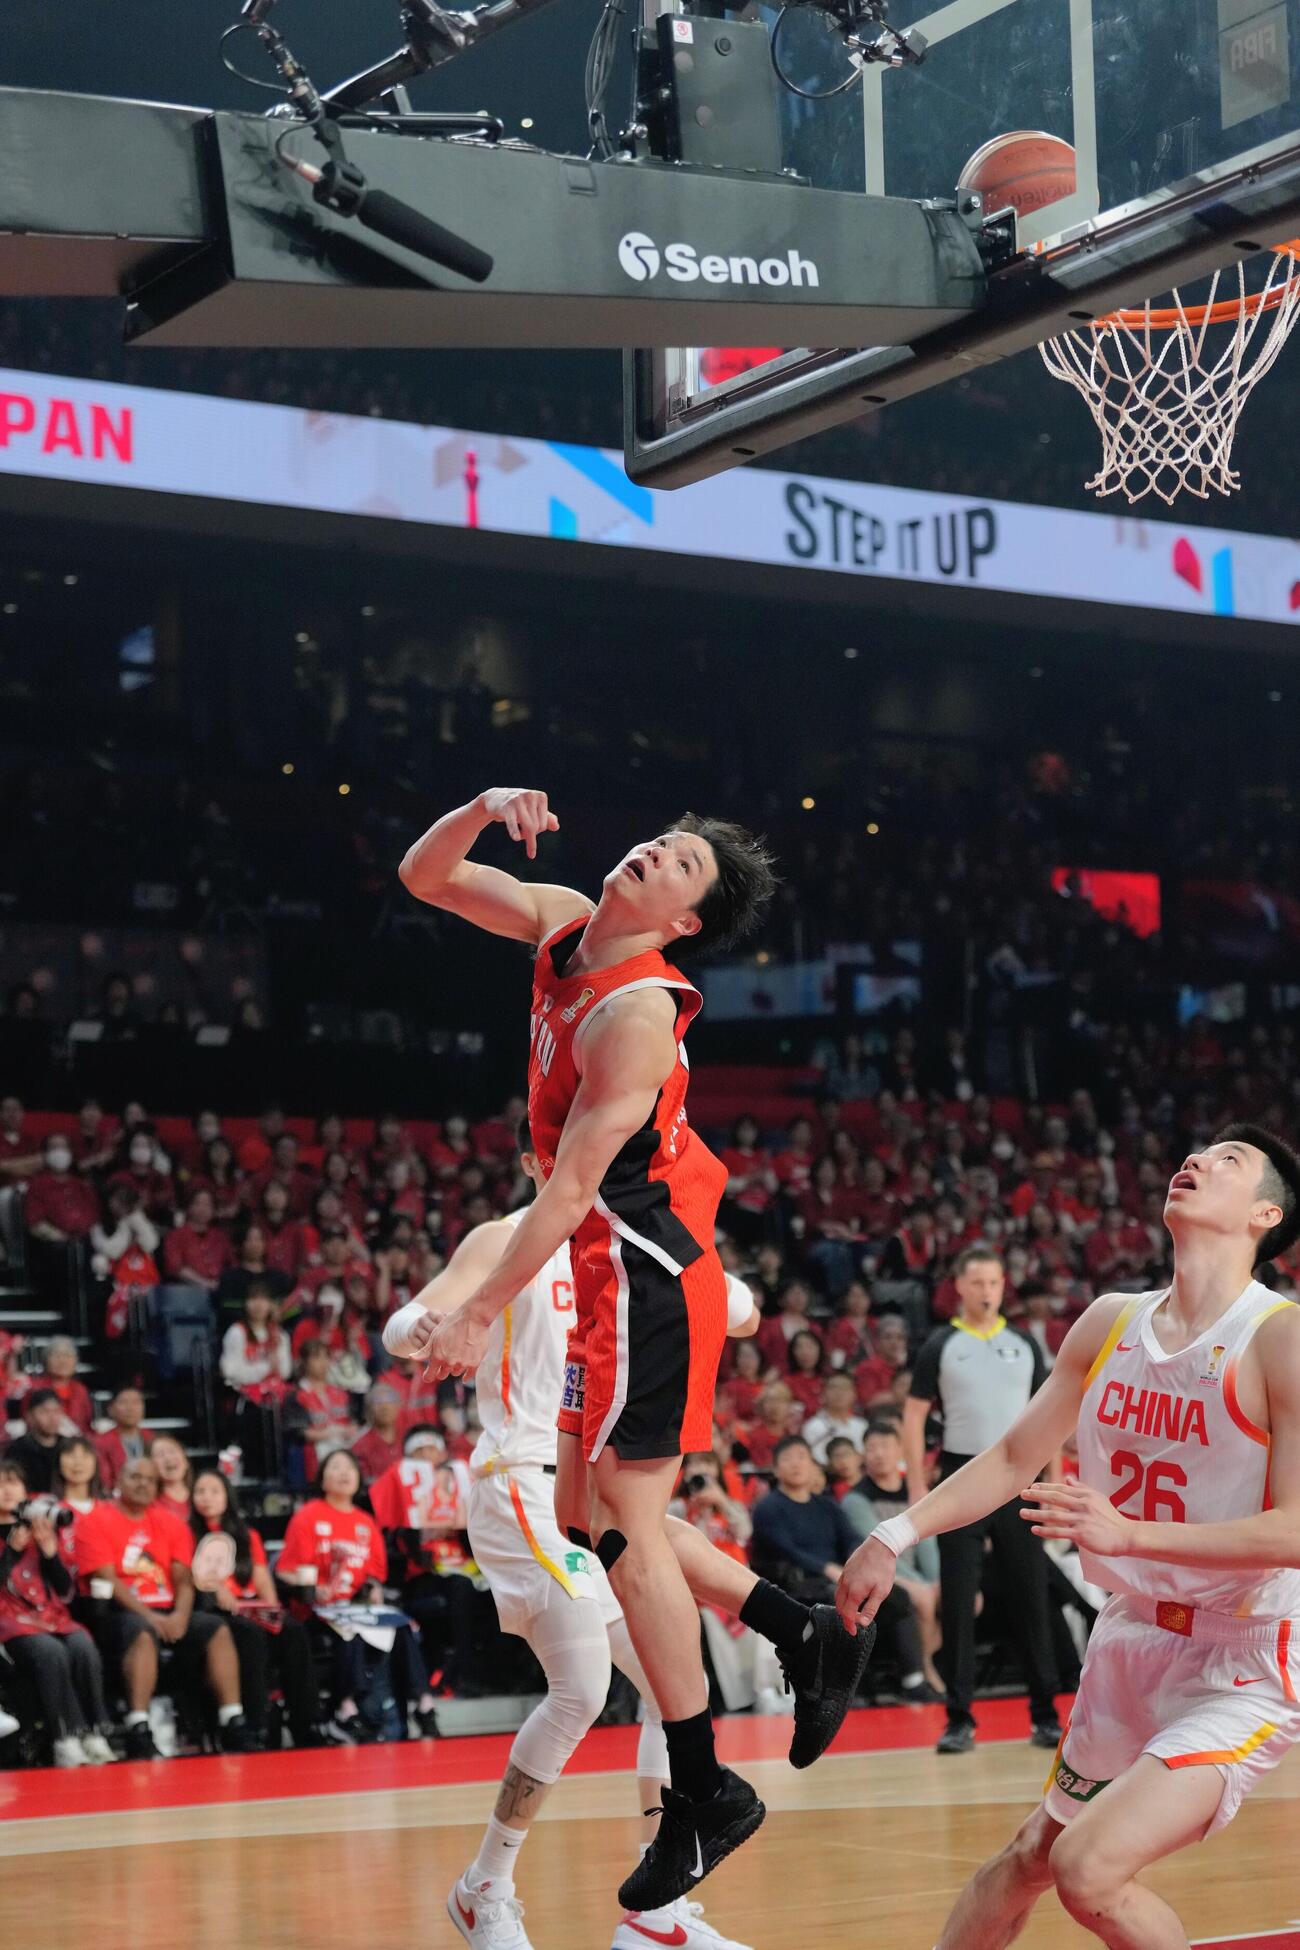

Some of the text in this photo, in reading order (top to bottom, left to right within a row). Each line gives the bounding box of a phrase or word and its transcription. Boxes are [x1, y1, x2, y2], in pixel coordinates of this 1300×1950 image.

[664, 242, 820, 287] Senoh
[0, 392, 132, 463] PAN
[785, 482, 996, 578] STEP IT UP
[1097, 1380, 1210, 1447] CHINA
[1109, 1449, 1187, 1523] 26
